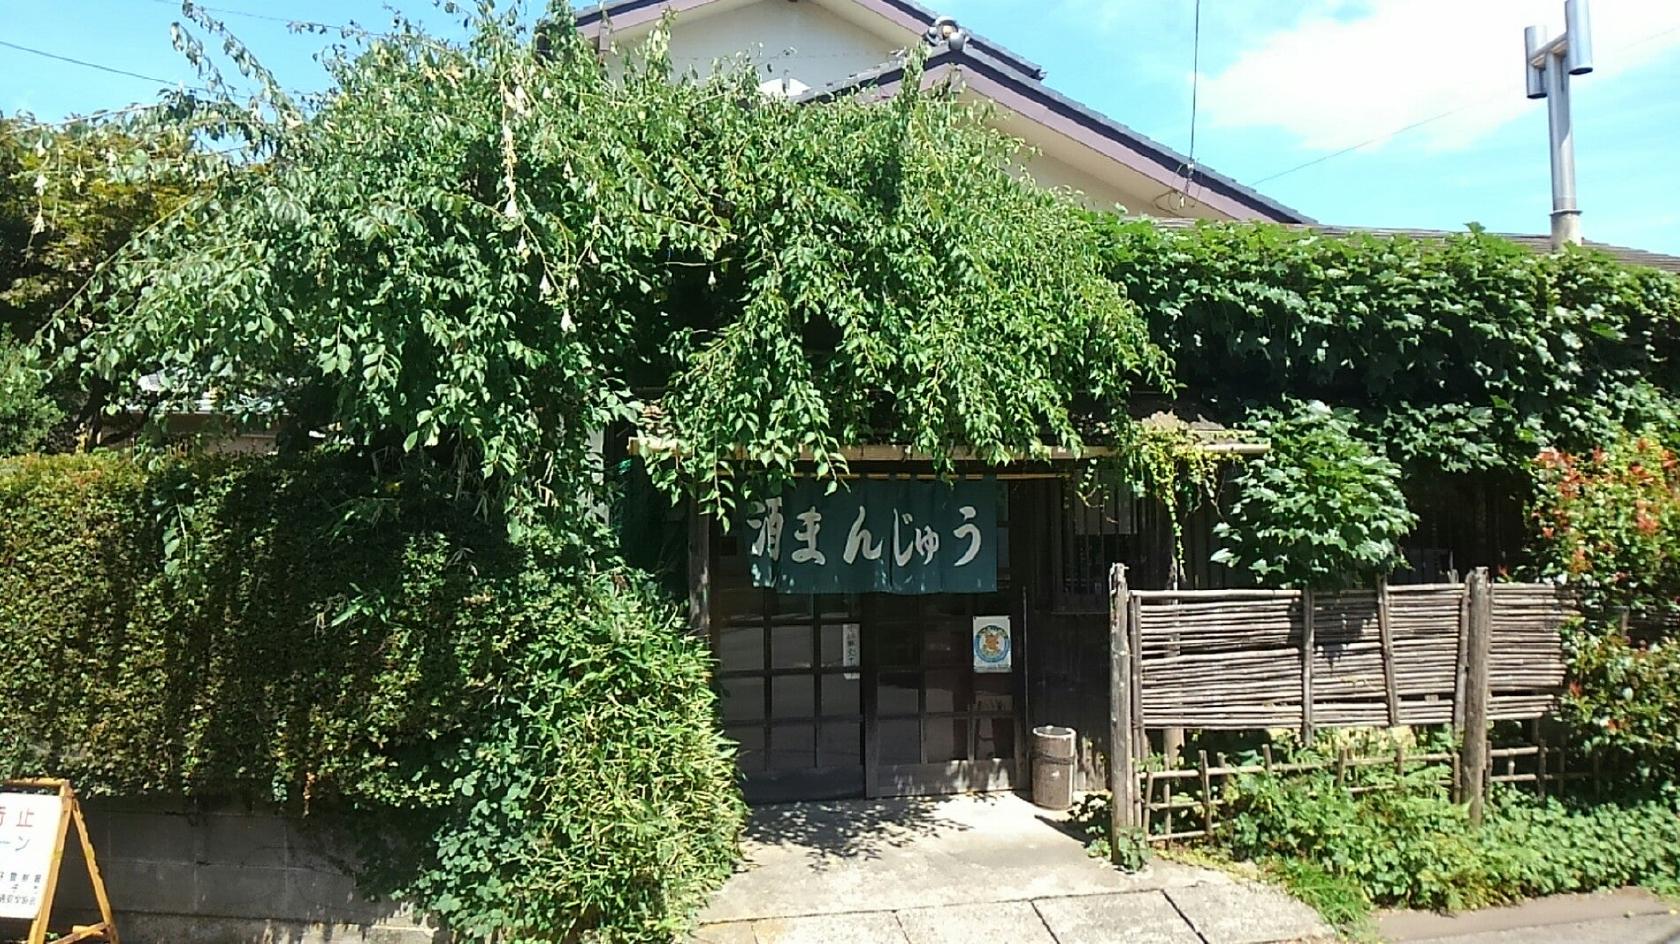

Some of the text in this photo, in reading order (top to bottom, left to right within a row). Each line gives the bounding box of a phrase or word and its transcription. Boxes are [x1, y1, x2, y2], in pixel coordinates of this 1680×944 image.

[747, 497, 981, 566] 酒まんじゅう
